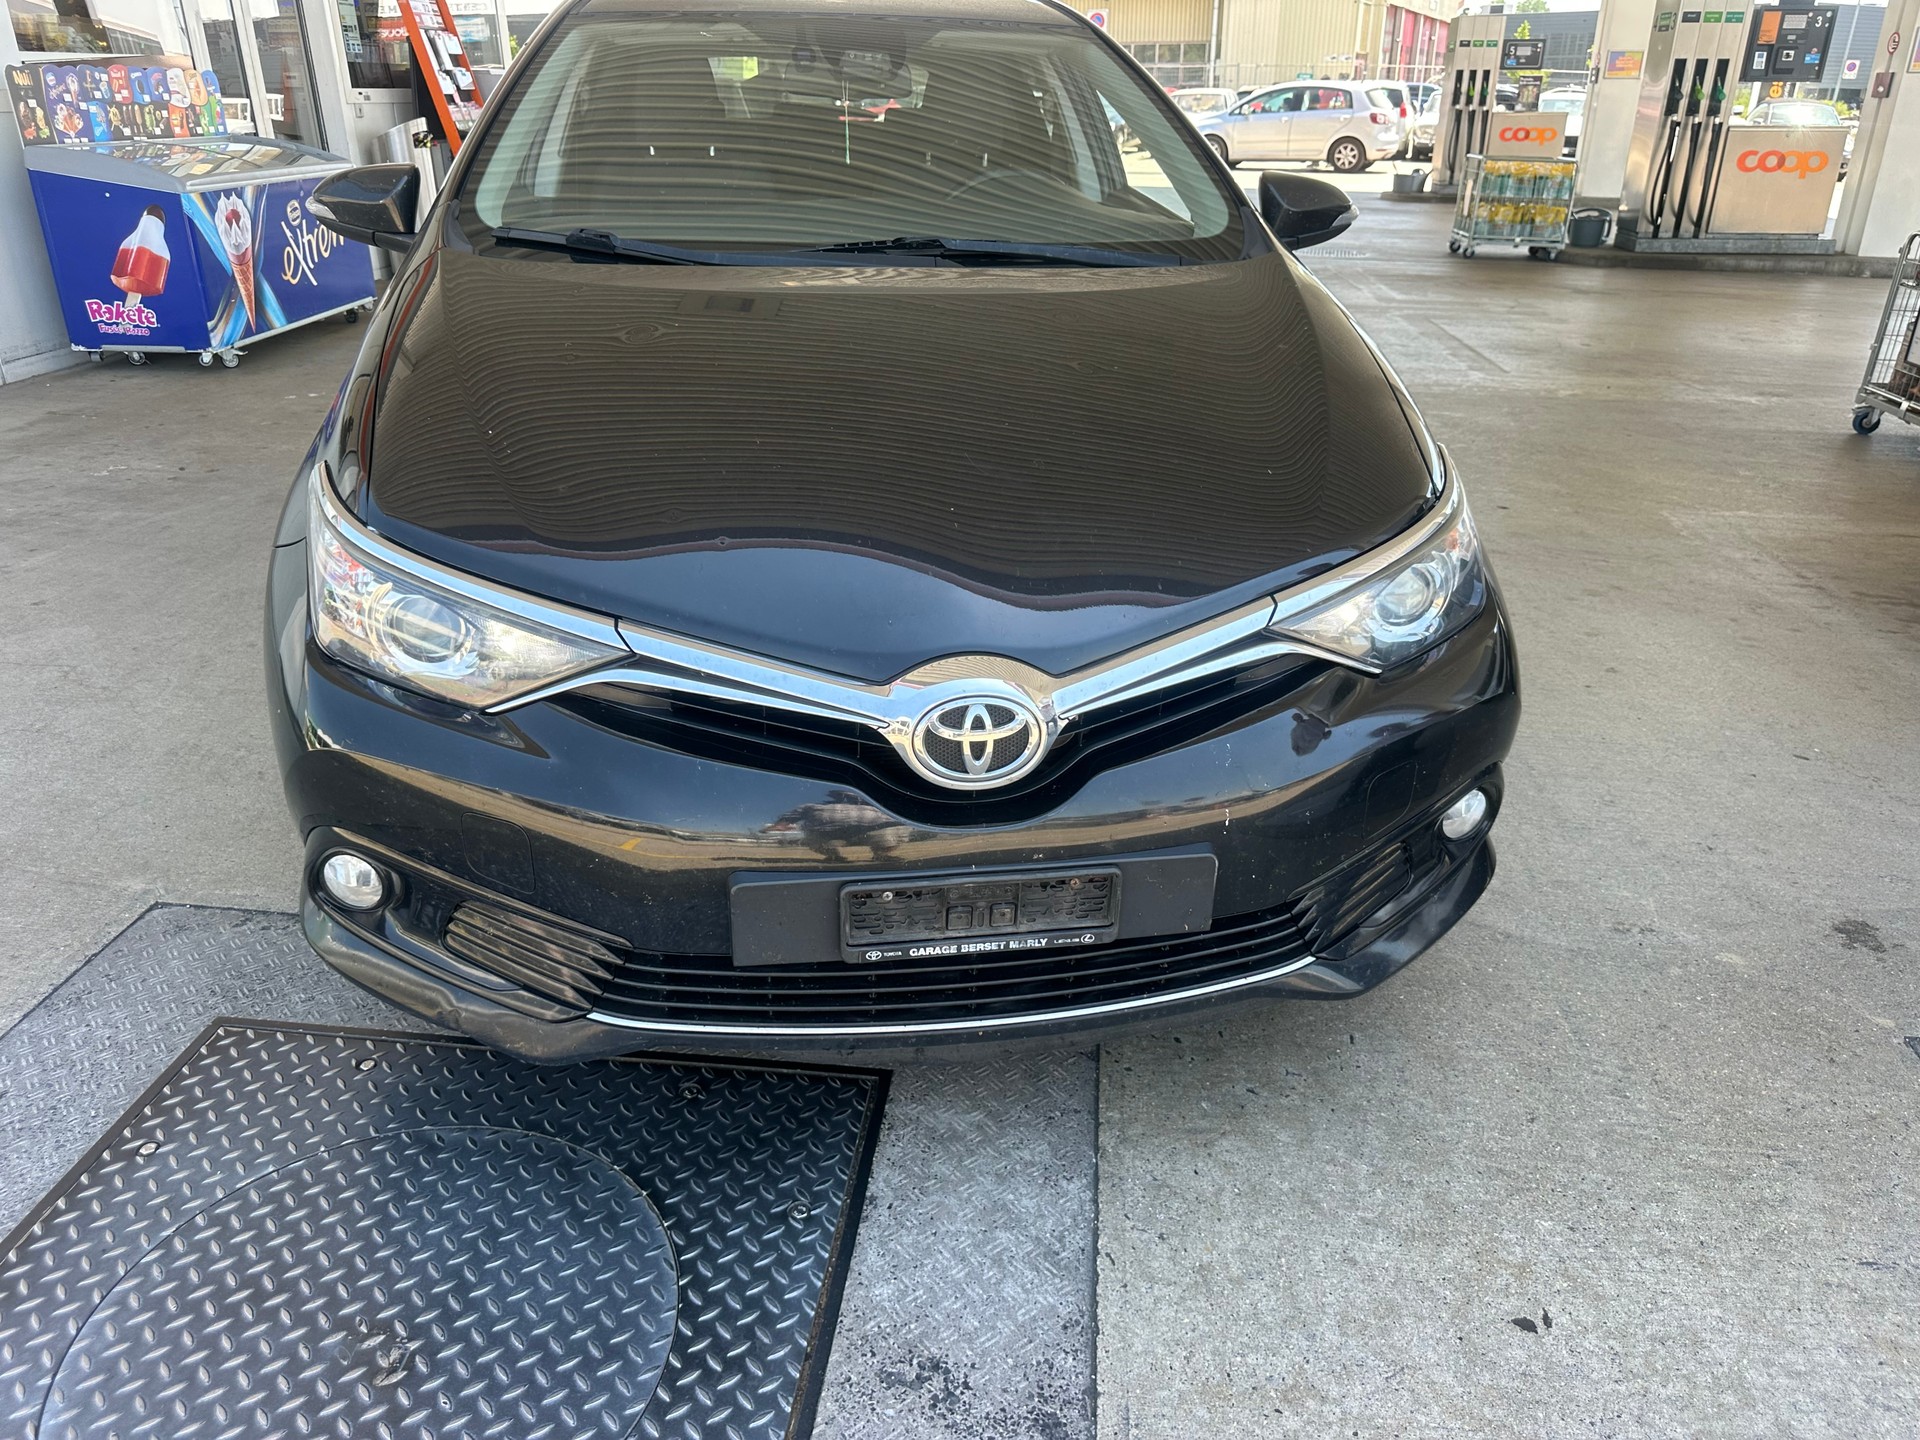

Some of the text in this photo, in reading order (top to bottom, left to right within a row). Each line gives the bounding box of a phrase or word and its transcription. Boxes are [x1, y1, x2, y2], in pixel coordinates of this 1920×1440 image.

[1815, 16, 1823, 28] 3
[1510, 46, 1516, 55] 5
[1499, 127, 1558, 147] coop
[1736, 150, 1829, 179] coop
[85, 299, 157, 327] Rakete
[909, 945, 958, 957] GARAGE
[960, 942, 1006, 953] BERSET
[1009, 938, 1048, 949] MARLY
